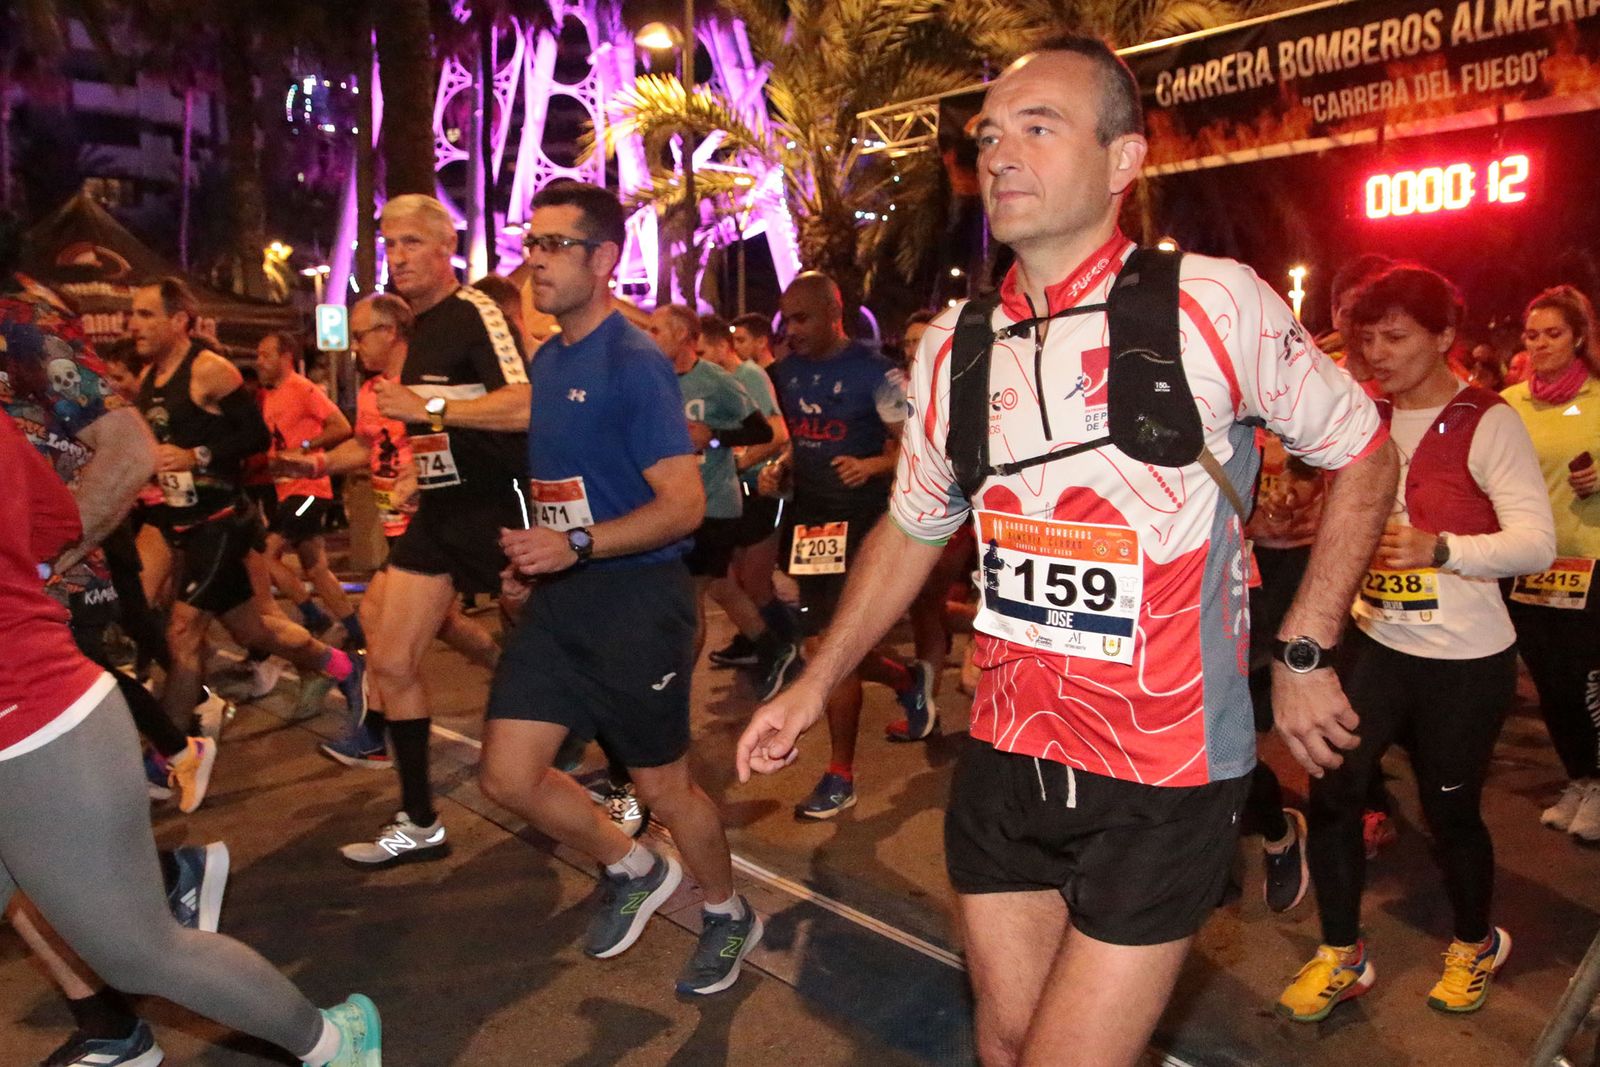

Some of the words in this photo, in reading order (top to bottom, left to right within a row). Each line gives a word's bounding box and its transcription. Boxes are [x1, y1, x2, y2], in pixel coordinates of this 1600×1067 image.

[1155, 46, 1275, 107] CARRERA
[1278, 8, 1444, 81] BOMBEROS
[1451, 0, 1600, 47] ALMER
[1414, 69, 1457, 103] DEL
[322, 307, 342, 335] P
[415, 454, 446, 475] 74
[808, 538, 838, 556] 203
[1015, 559, 1116, 611] 159
[1365, 572, 1422, 593] 2238
[1533, 572, 1580, 587] 2415
[1046, 610, 1074, 628] JOSE
